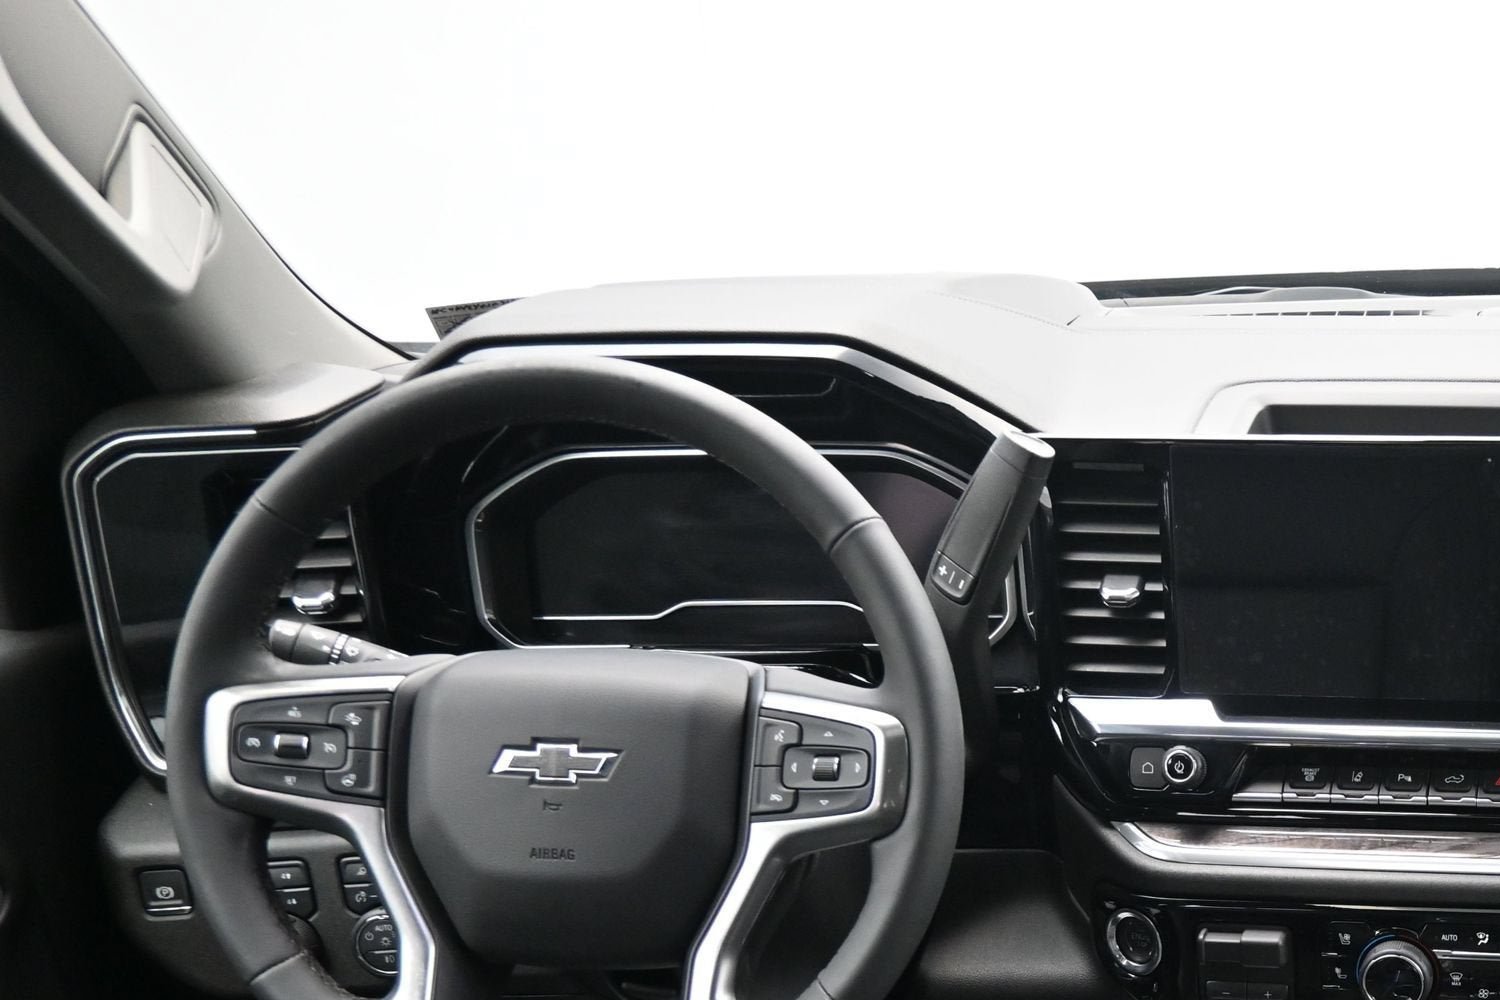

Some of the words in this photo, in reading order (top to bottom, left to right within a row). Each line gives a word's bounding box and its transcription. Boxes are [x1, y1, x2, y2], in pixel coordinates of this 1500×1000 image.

[529, 847, 576, 860] AIRBAG
[375, 924, 393, 932] AUTO
[1441, 934, 1458, 942] AUTO
